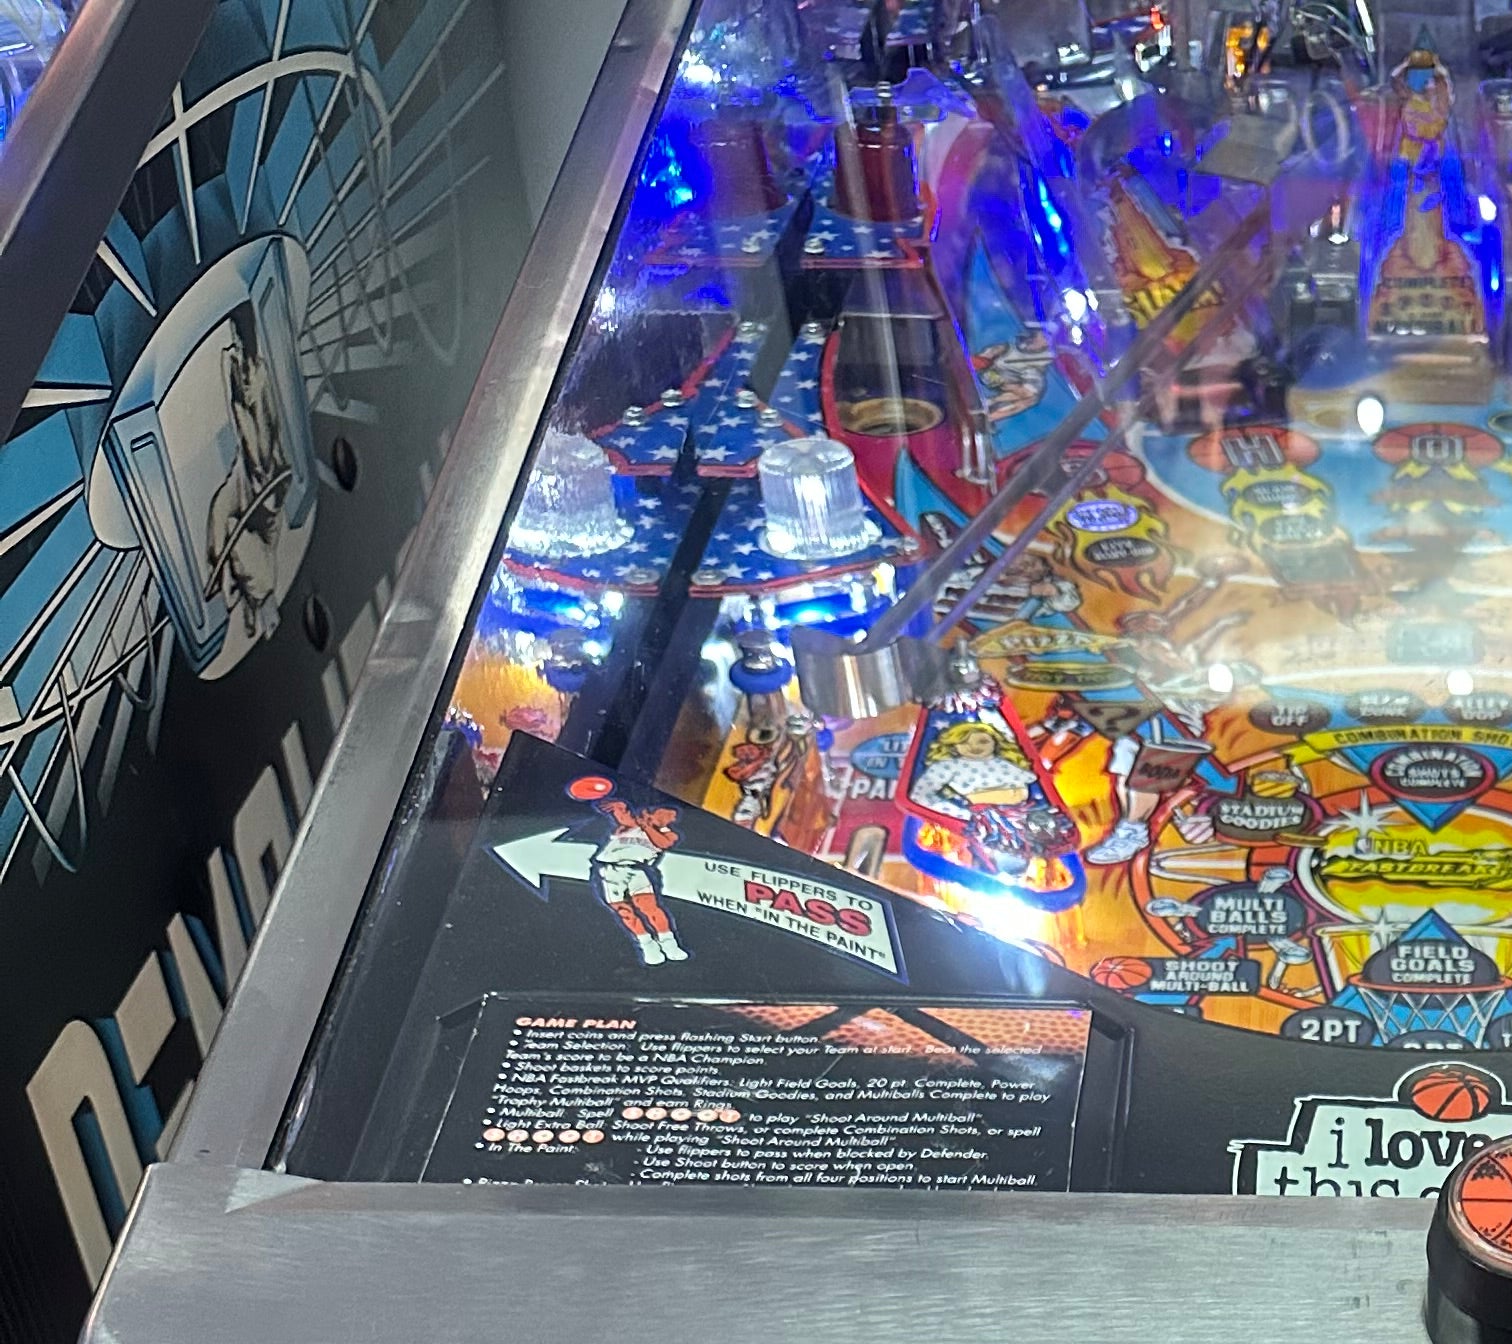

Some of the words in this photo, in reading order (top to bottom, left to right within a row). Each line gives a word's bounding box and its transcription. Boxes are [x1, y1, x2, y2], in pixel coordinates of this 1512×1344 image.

[1333, 727, 1464, 745] COMBINATION
[1220, 803, 1304, 818] STADIUM
[1220, 814, 1301, 830] GOODIES
[1373, 839, 1429, 855] NBA
[704, 861, 741, 878] USE
[751, 870, 837, 901] FLIPPERS
[846, 895, 873, 911] TO
[744, 879, 872, 937] PASS
[1214, 897, 1285, 911] MULTI
[696, 889, 748, 914] WHEN
[785, 915, 820, 938] THE
[1210, 910, 1288, 924] BALLS
[1208, 923, 1287, 935] COMPLETE
[1398, 945, 1469, 960] FIELD
[1165, 960, 1239, 971] SHOOT
[1390, 958, 1475, 972] GOALS
[1165, 971, 1234, 981] AROUND
[1392, 972, 1472, 985] COMPLETE
[1150, 980, 1249, 992] MULTI-BALL
[515, 1017, 578, 1028] GAME
[582, 1018, 637, 1029] PLAN
[526, 1029, 564, 1040] Insert
[567, 1030, 603, 1040] coins
[607, 1030, 637, 1041] and
[639, 1032, 676, 1043] press
[680, 1031, 734, 1044] flashing
[739, 1033, 771, 1043] Start
[1302, 1019, 1362, 1043] 2PT
[514, 1062, 557, 1072] Shoot
[562, 1063, 612, 1073] baskets
[617, 1064, 630, 1073] to
[634, 1065, 672, 1074] score
[496, 1119, 532, 1131] Light
[535, 1120, 572, 1130] Extra
[611, 1120, 654, 1131] Shoot
[659, 1121, 689, 1131] Free
[773, 1125, 839, 1137] complete
[843, 1124, 935, 1135] Combination
[987, 1127, 1003, 1136] or
[1007, 1127, 1042, 1138] spell
[488, 1143, 502, 1152] In
[507, 1143, 532, 1153] The
[1328, 1117, 1349, 1169] i
[646, 1145, 673, 1155] Use
[677, 1145, 733, 1158] flippers
[736, 1147, 750, 1156] to
[754, 1149, 787, 1160] pass
[792, 1149, 832, 1158] when
[836, 1148, 893, 1159] blocked
[897, 1149, 916, 1161] by
[643, 1158, 670, 1168] Use
[674, 1158, 717, 1168] Shoot
[721, 1159, 767, 1170] button
[771, 1161, 786, 1171] to
[790, 1162, 830, 1171] score
[834, 1161, 872, 1171] when
[639, 1170, 710, 1182] Complete
[715, 1171, 750, 1182] shots
[755, 1172, 788, 1182] from
[793, 1173, 811, 1183] all
[816, 1173, 845, 1183] four
[849, 1173, 912, 1187] positions
[917, 1174, 932, 1184] to
[936, 1174, 968, 1185] start
